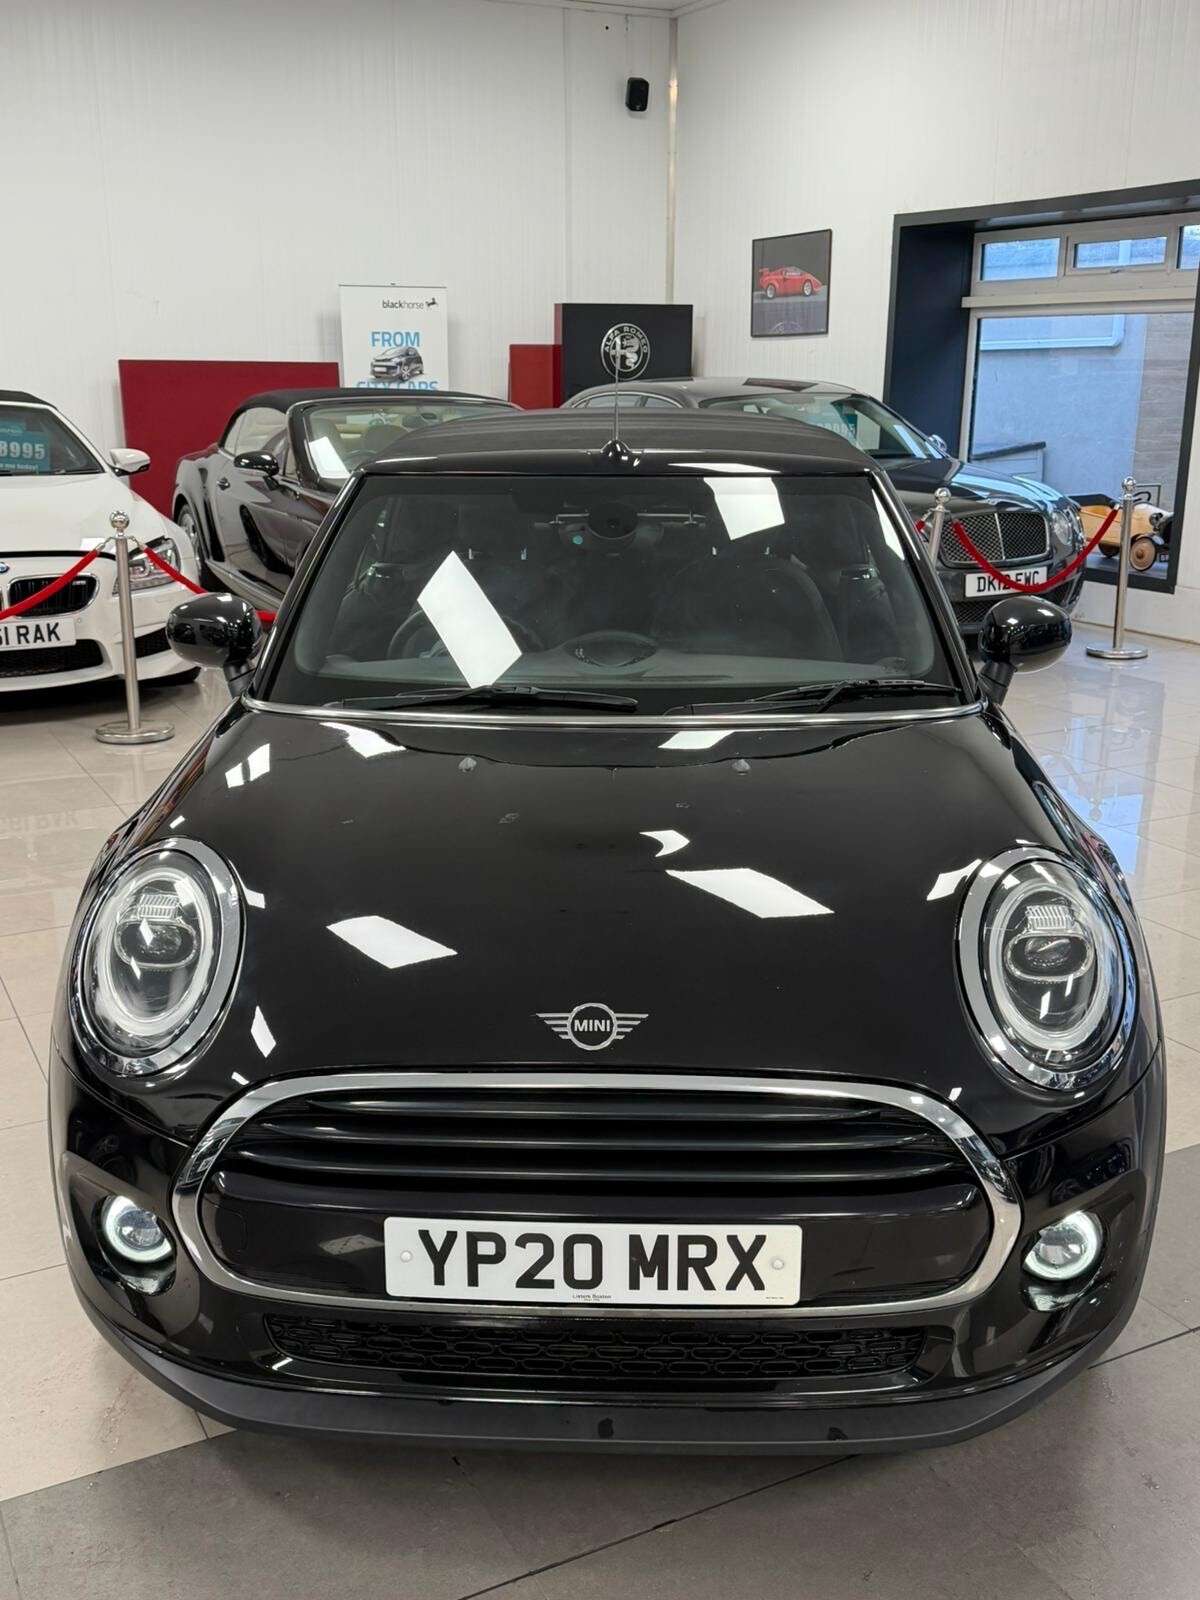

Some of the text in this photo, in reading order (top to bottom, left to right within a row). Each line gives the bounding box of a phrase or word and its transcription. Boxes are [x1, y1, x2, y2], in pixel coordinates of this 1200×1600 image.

[382, 299, 425, 309] blackhorse
[370, 331, 420, 347] FROM
[604, 326, 648, 353] ALFA ROMEO
[16, 622, 61, 645] RAK
[574, 1019, 610, 1032] MINI
[418, 1229, 767, 1291] YP20 MRX
